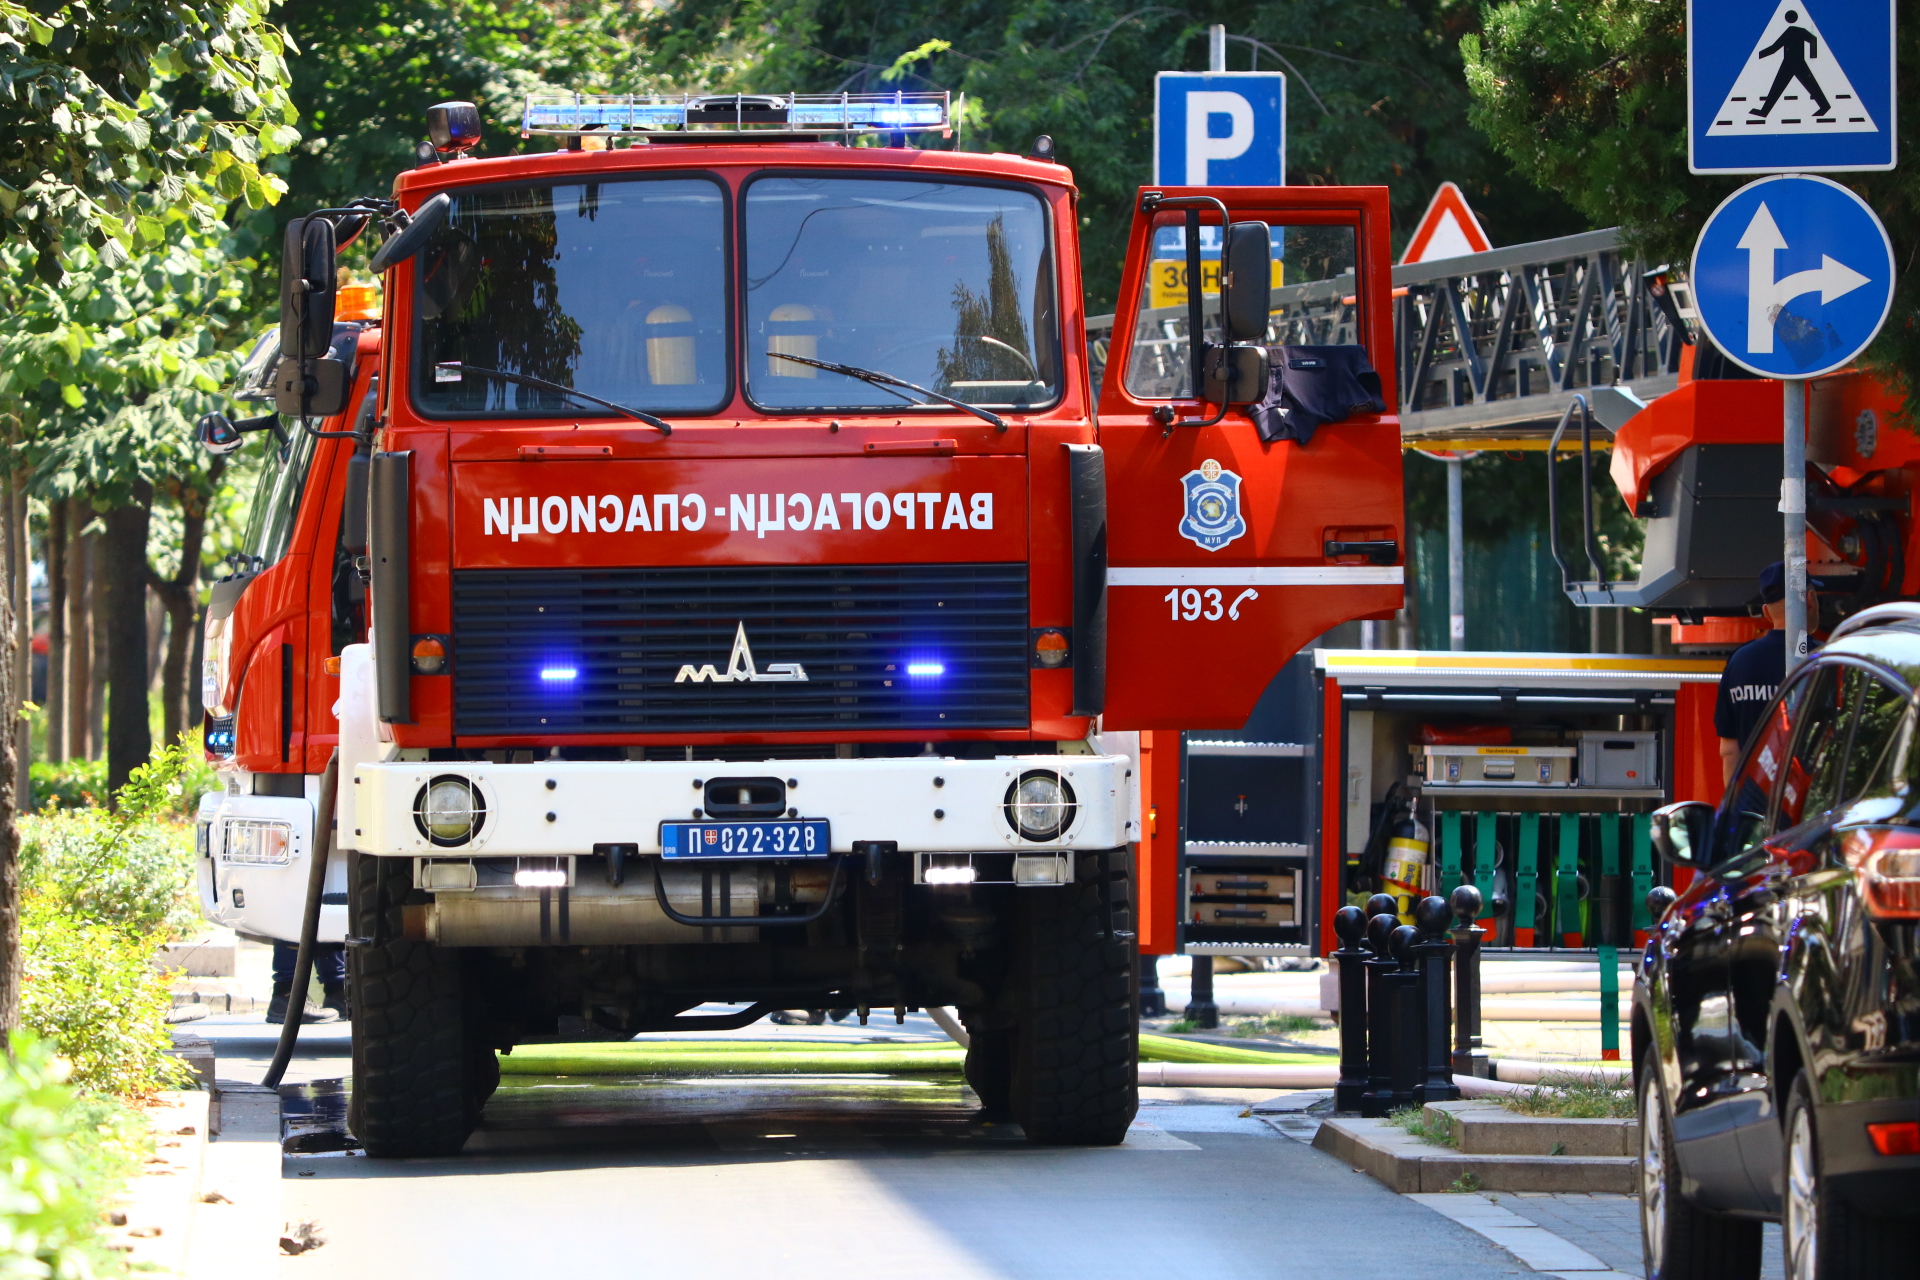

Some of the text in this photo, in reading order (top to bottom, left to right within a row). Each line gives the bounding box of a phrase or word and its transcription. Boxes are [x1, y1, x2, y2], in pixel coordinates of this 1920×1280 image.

[1184, 90, 1255, 187] P
[1163, 266, 1220, 289] ЗН
[1204, 536, 1221, 544] МУП
[1164, 587, 1224, 621] 193
[1729, 684, 1780, 704] ПОЛИЦ
[664, 846, 676, 854] SRB
